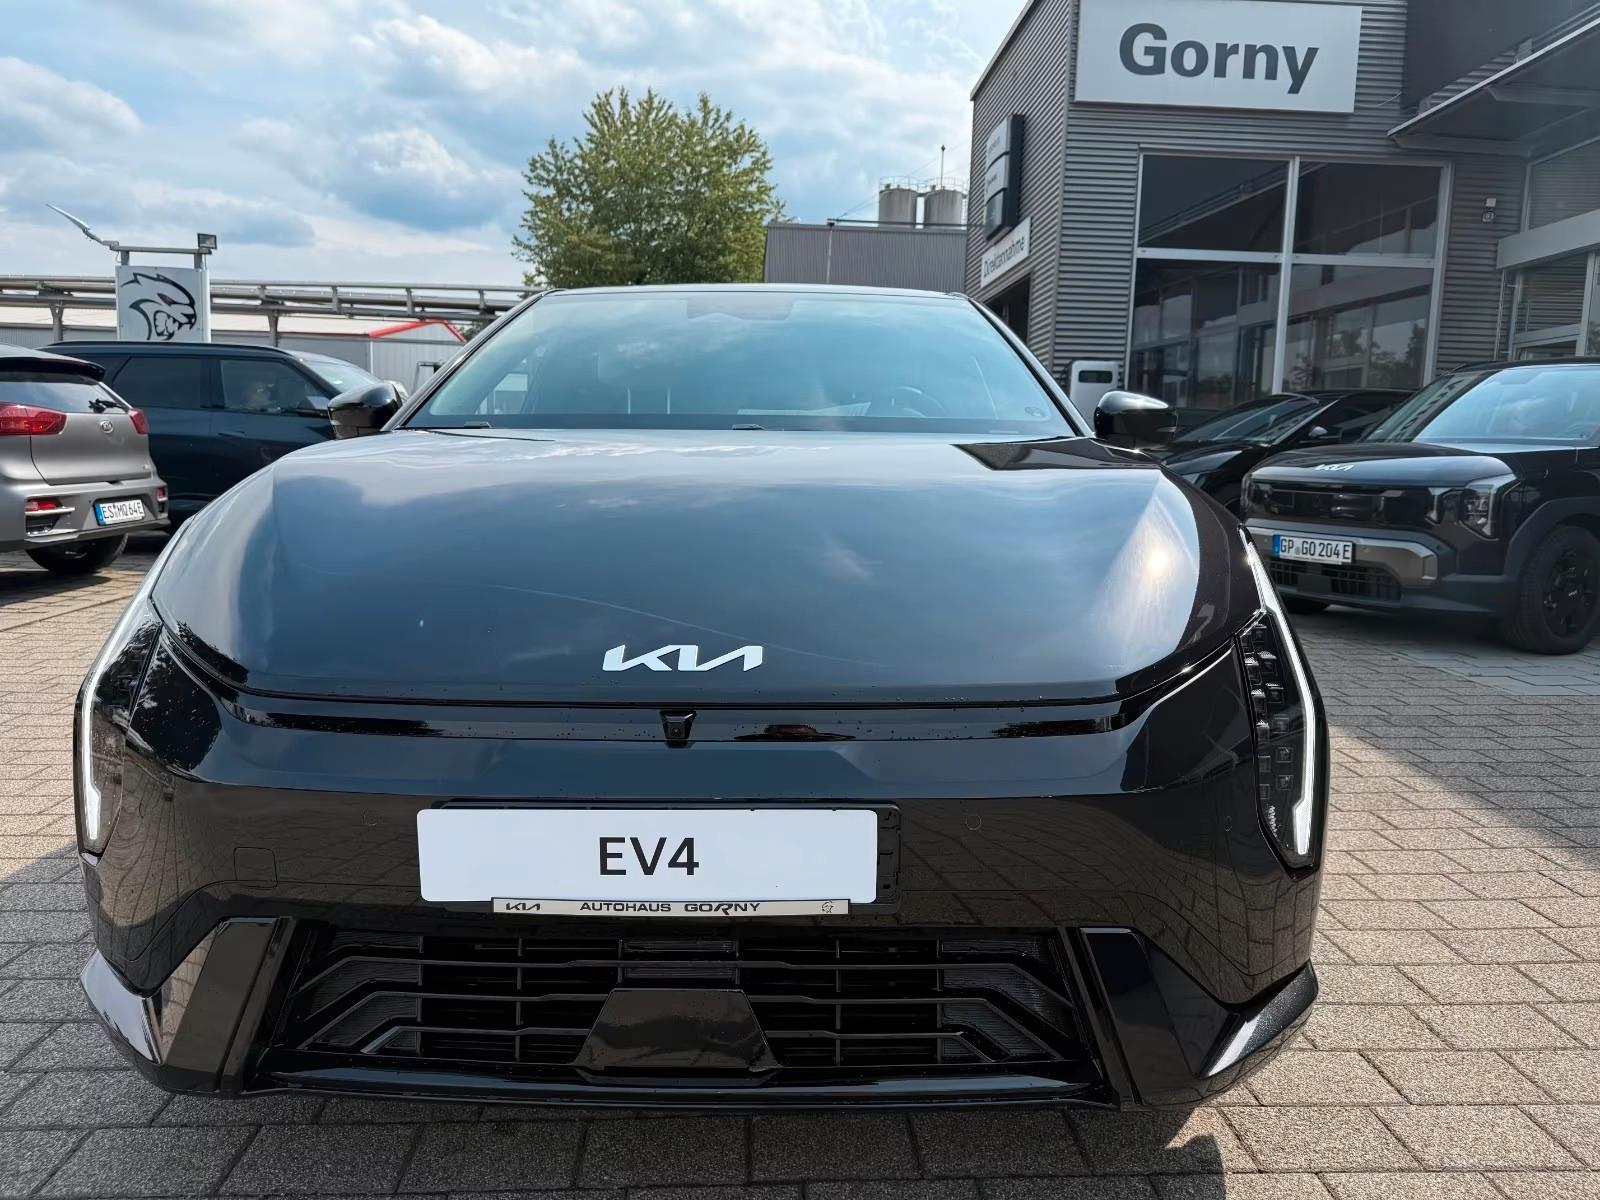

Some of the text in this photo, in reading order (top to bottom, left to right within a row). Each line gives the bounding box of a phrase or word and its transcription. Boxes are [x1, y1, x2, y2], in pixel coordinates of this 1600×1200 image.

[1119, 23, 1319, 94] Gorny
[1280, 539, 1294, 553] GP
[602, 645, 763, 671] KIA
[599, 837, 700, 876] EV4
[506, 903, 760, 915] KIA AUTOHAUS GORNY
